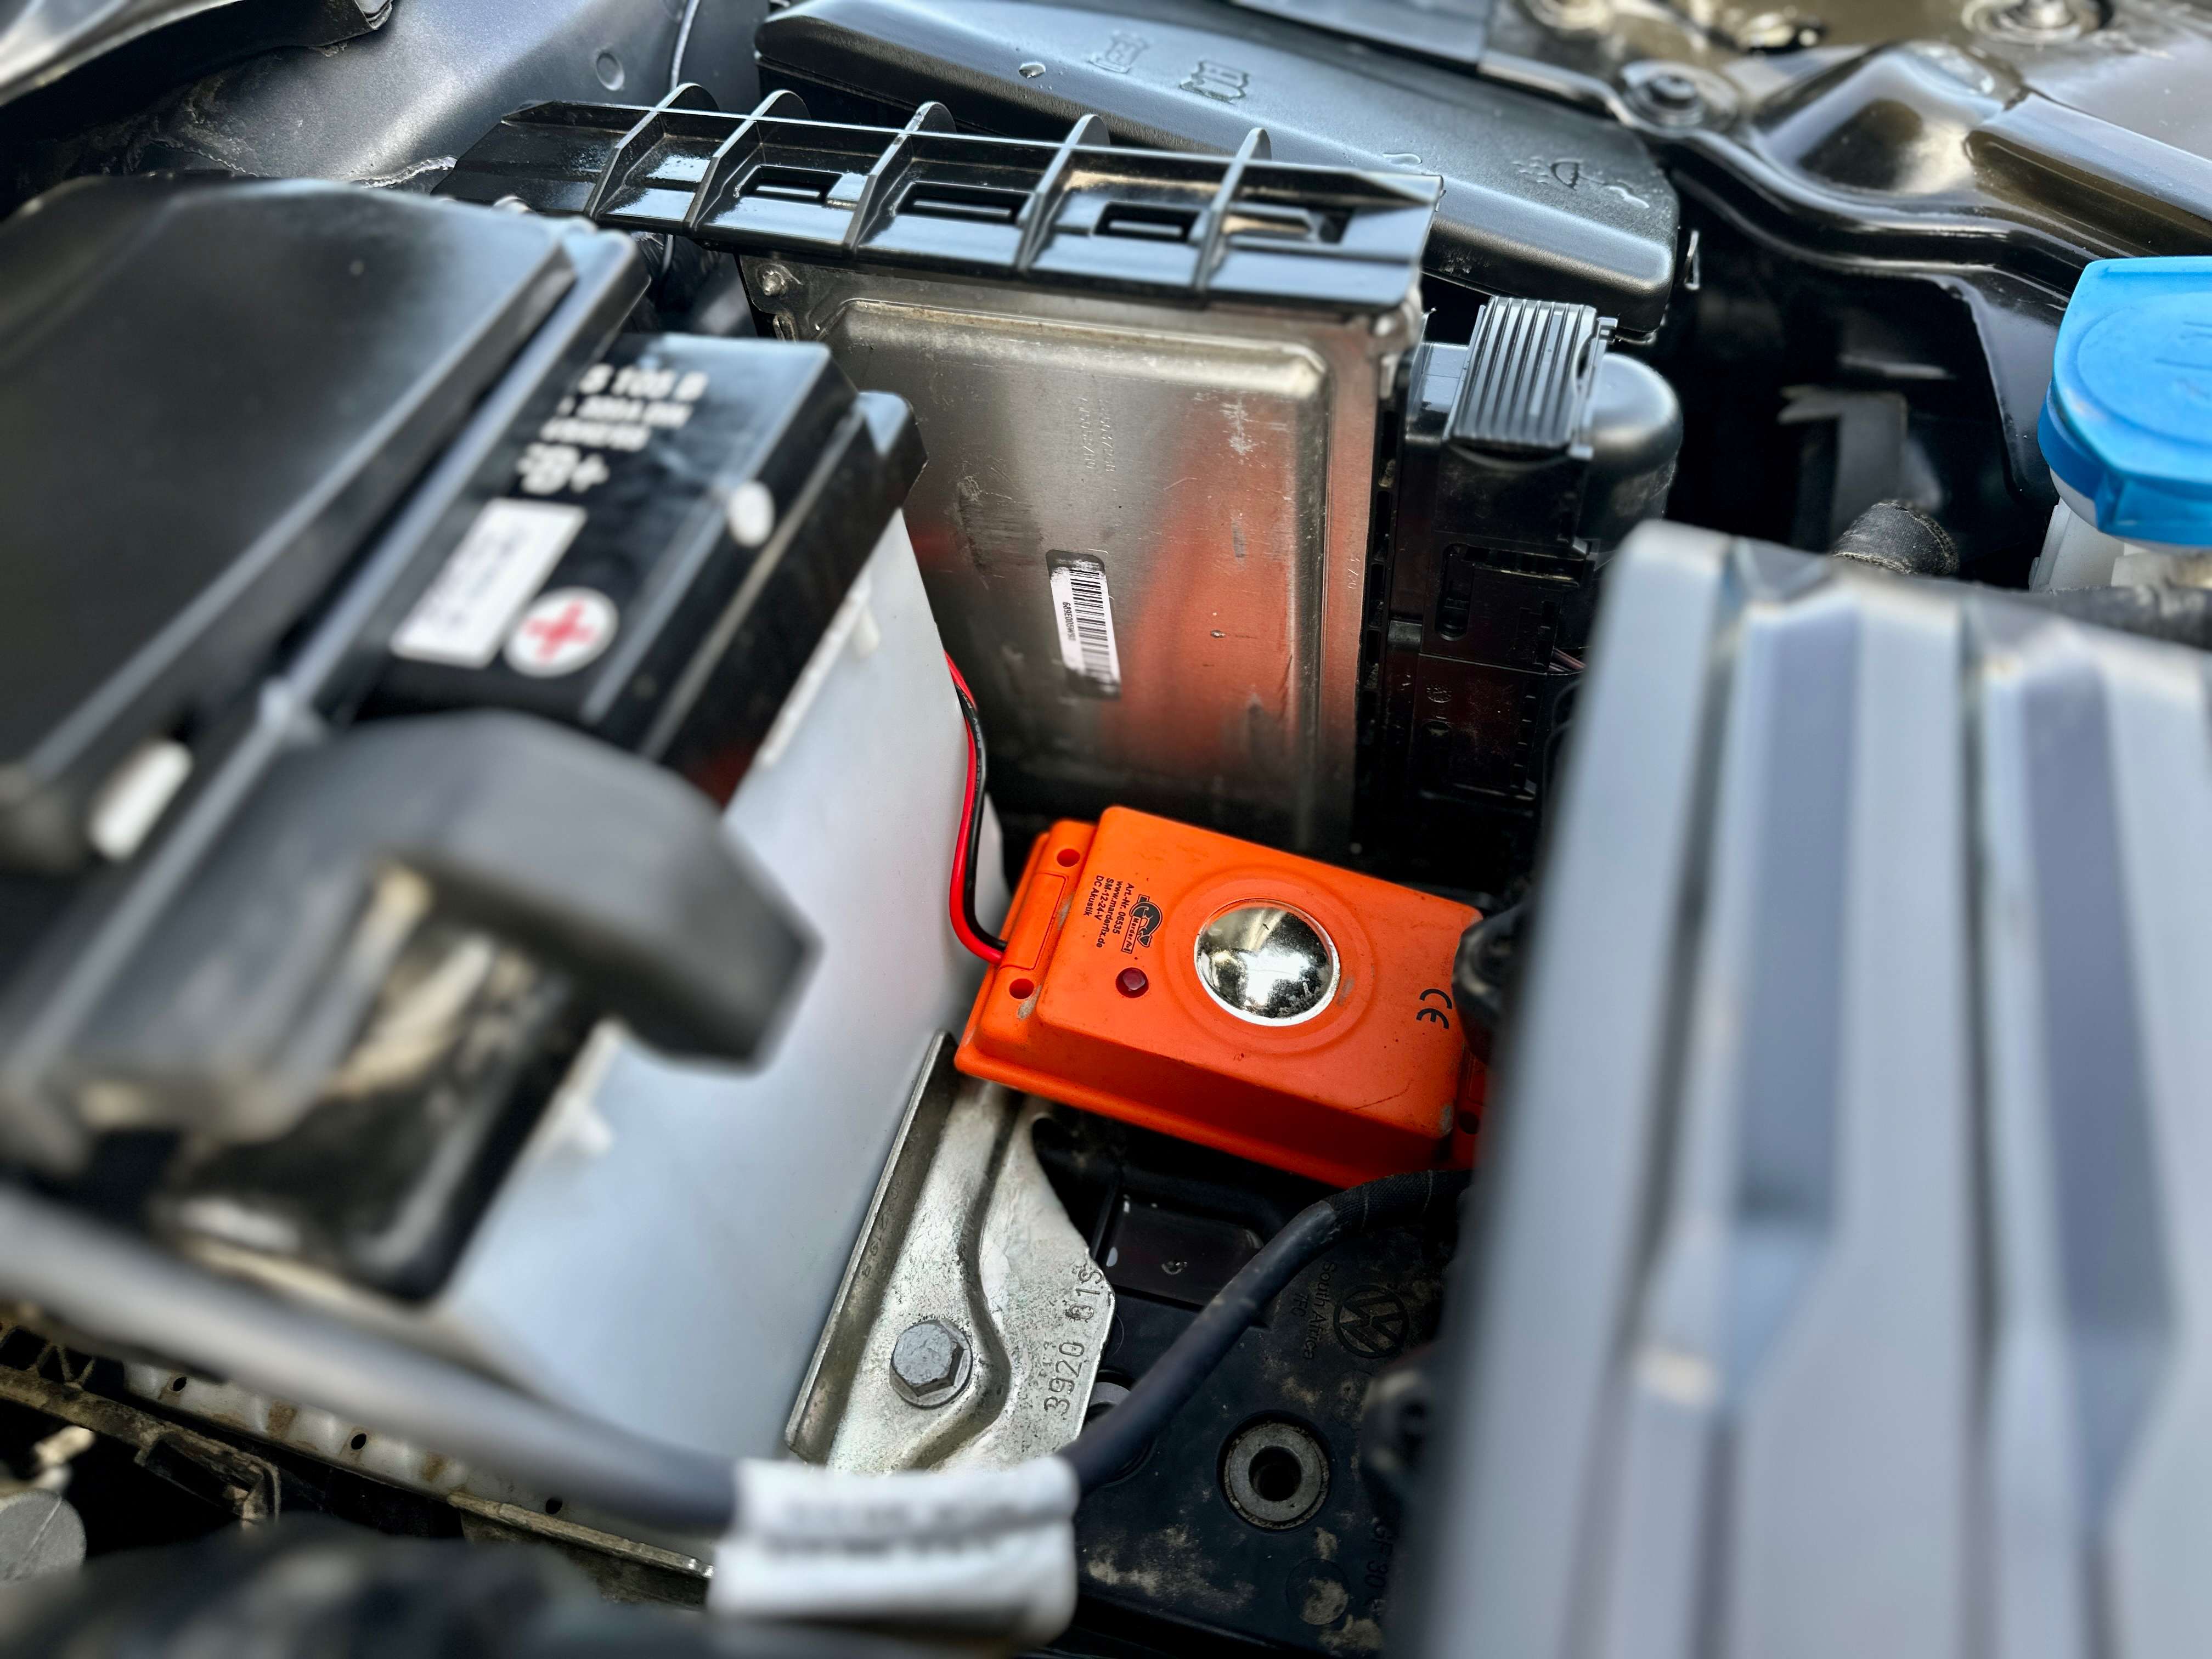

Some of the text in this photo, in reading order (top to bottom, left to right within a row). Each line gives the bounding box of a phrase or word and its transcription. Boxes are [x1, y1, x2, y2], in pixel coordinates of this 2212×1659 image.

[1084, 875, 1104, 916] DC Akustik
[1096, 881, 1123, 948] www.marderfix.de
[1113, 883, 1135, 934] Art.-Nr. 06535
[1416, 989, 1453, 1029] CE
[1043, 1342, 1085, 1416] 3920
